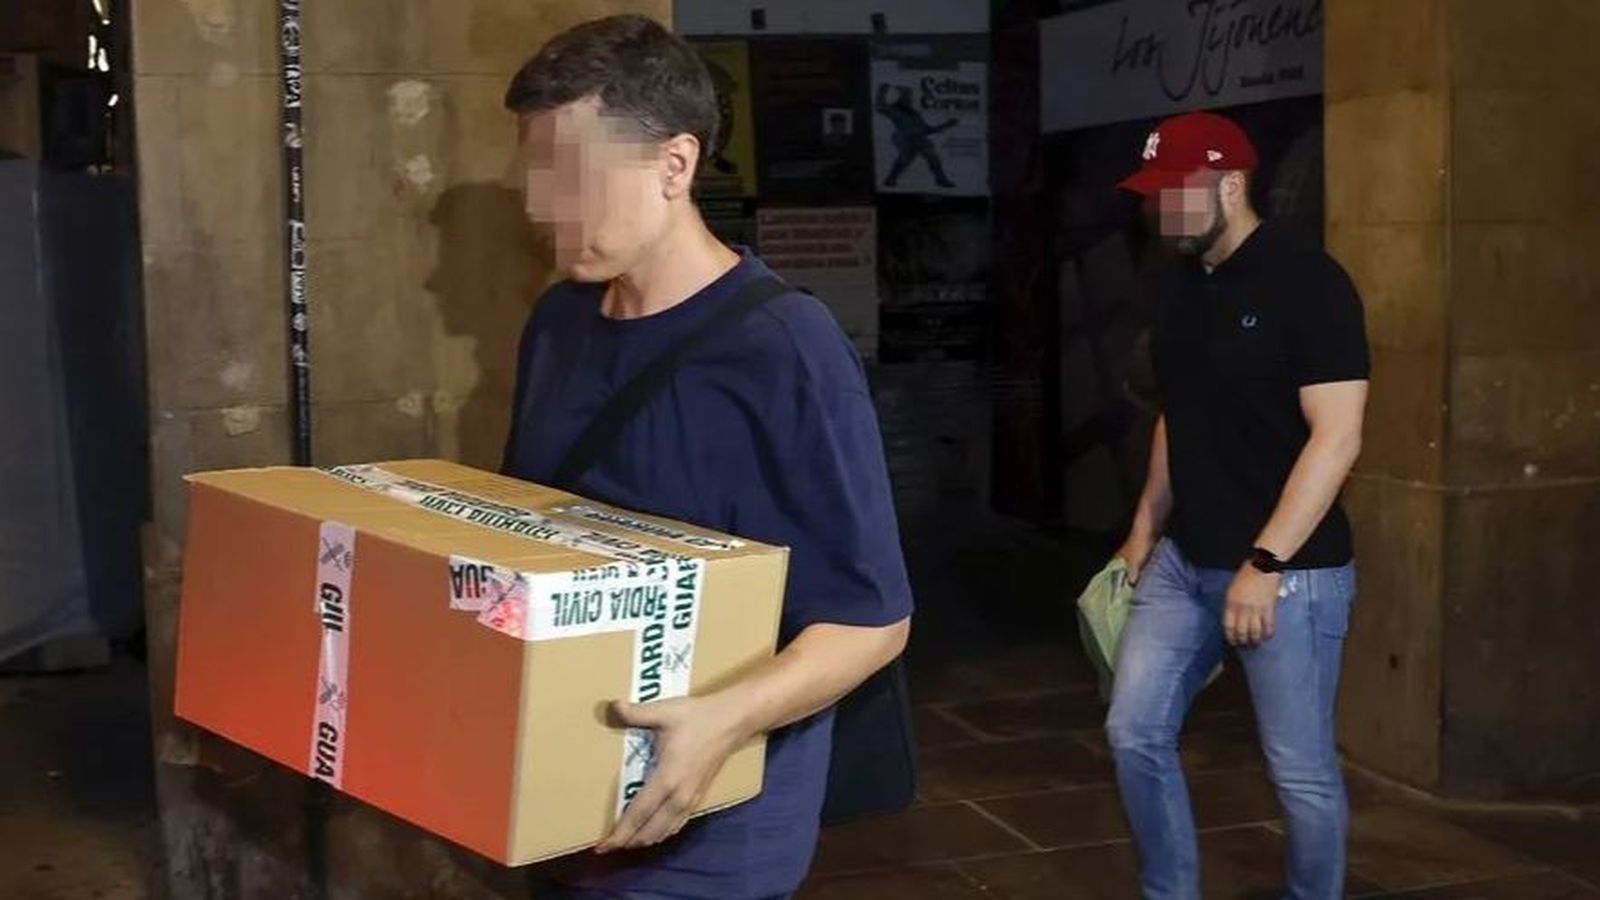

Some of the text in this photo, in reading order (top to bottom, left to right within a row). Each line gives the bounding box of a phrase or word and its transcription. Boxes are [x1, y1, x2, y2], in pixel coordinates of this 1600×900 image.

[1111, 15, 1162, 75] Los
[550, 590, 602, 627] CIVIL
[315, 721, 338, 777] GUA
